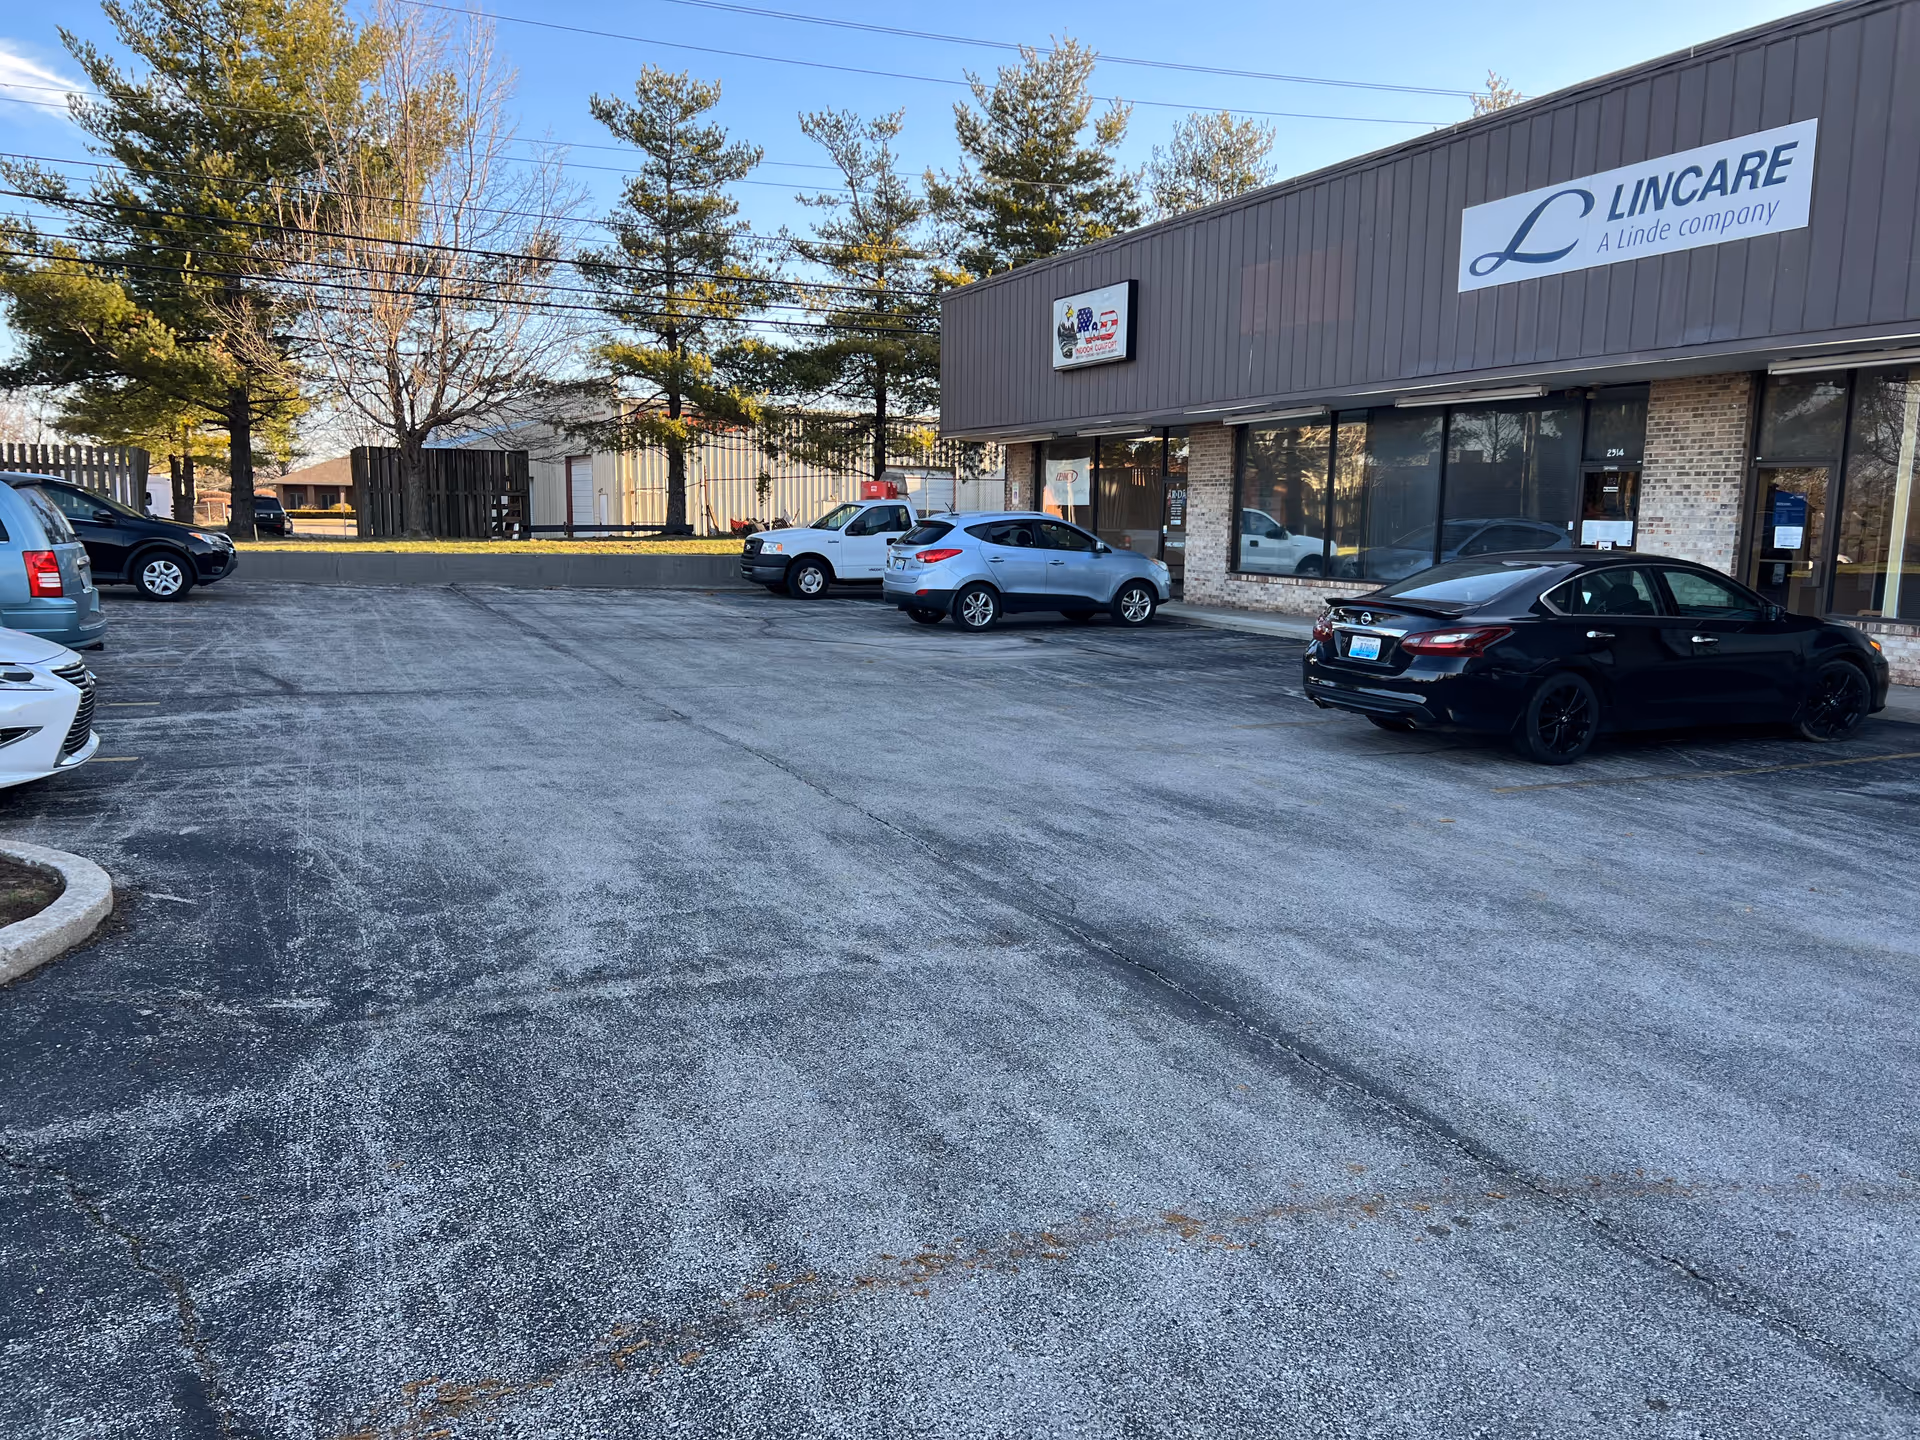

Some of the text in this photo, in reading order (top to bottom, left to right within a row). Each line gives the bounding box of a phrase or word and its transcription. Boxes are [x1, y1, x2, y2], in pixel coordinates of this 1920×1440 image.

[1606, 140, 1799, 222] LINCARE
[1597, 200, 1780, 253] A Linde company
[1095, 341, 1117, 351] COMFORT
